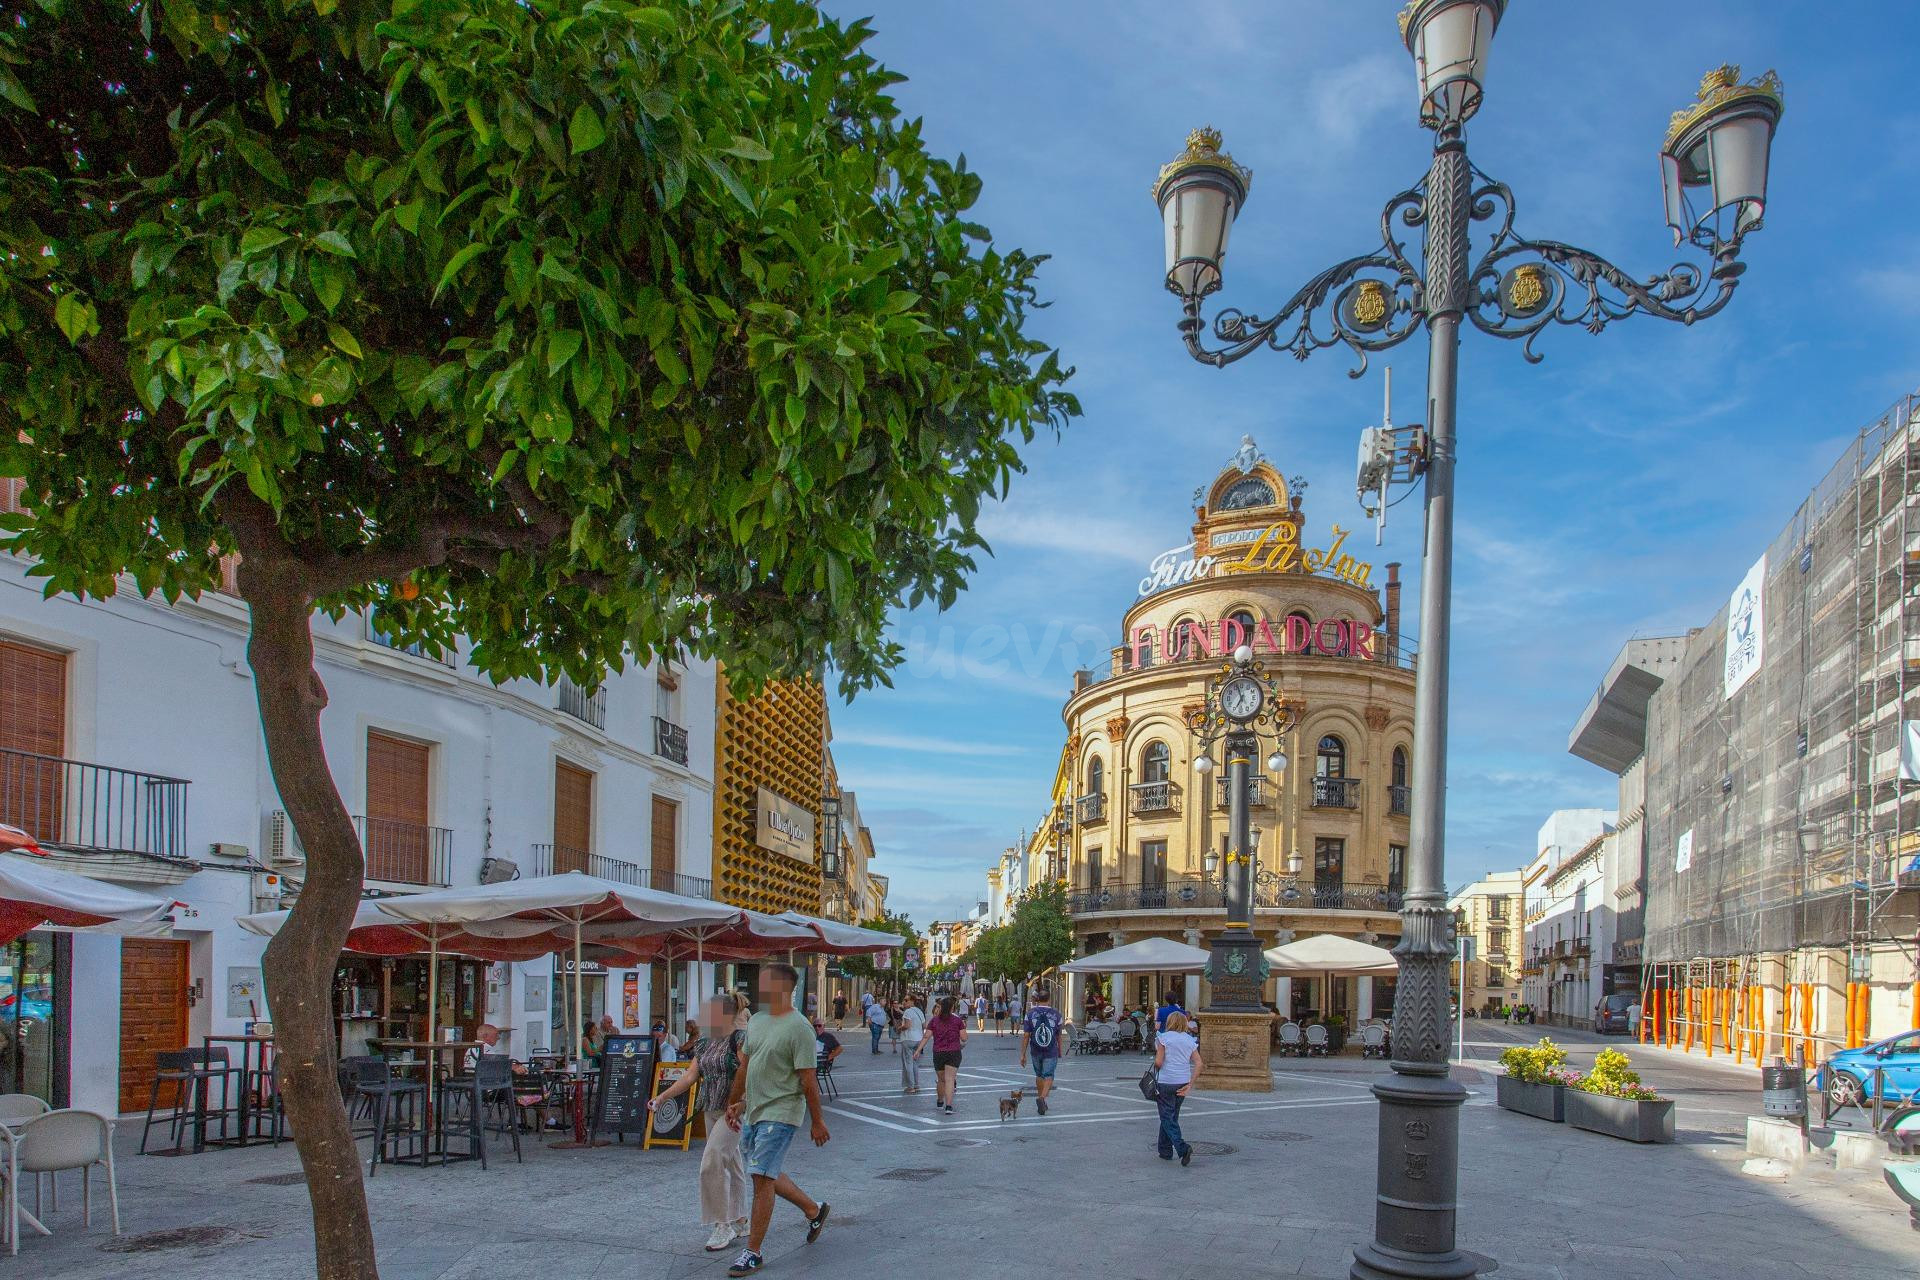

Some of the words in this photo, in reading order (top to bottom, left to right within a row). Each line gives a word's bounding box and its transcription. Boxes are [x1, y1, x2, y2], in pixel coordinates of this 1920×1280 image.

[1138, 541, 1217, 596] Fino
[1222, 520, 1298, 572] La
[1302, 523, 1374, 590] Ina
[1130, 615, 1375, 670] FUNDADOR
[184, 909, 198, 918] 25
